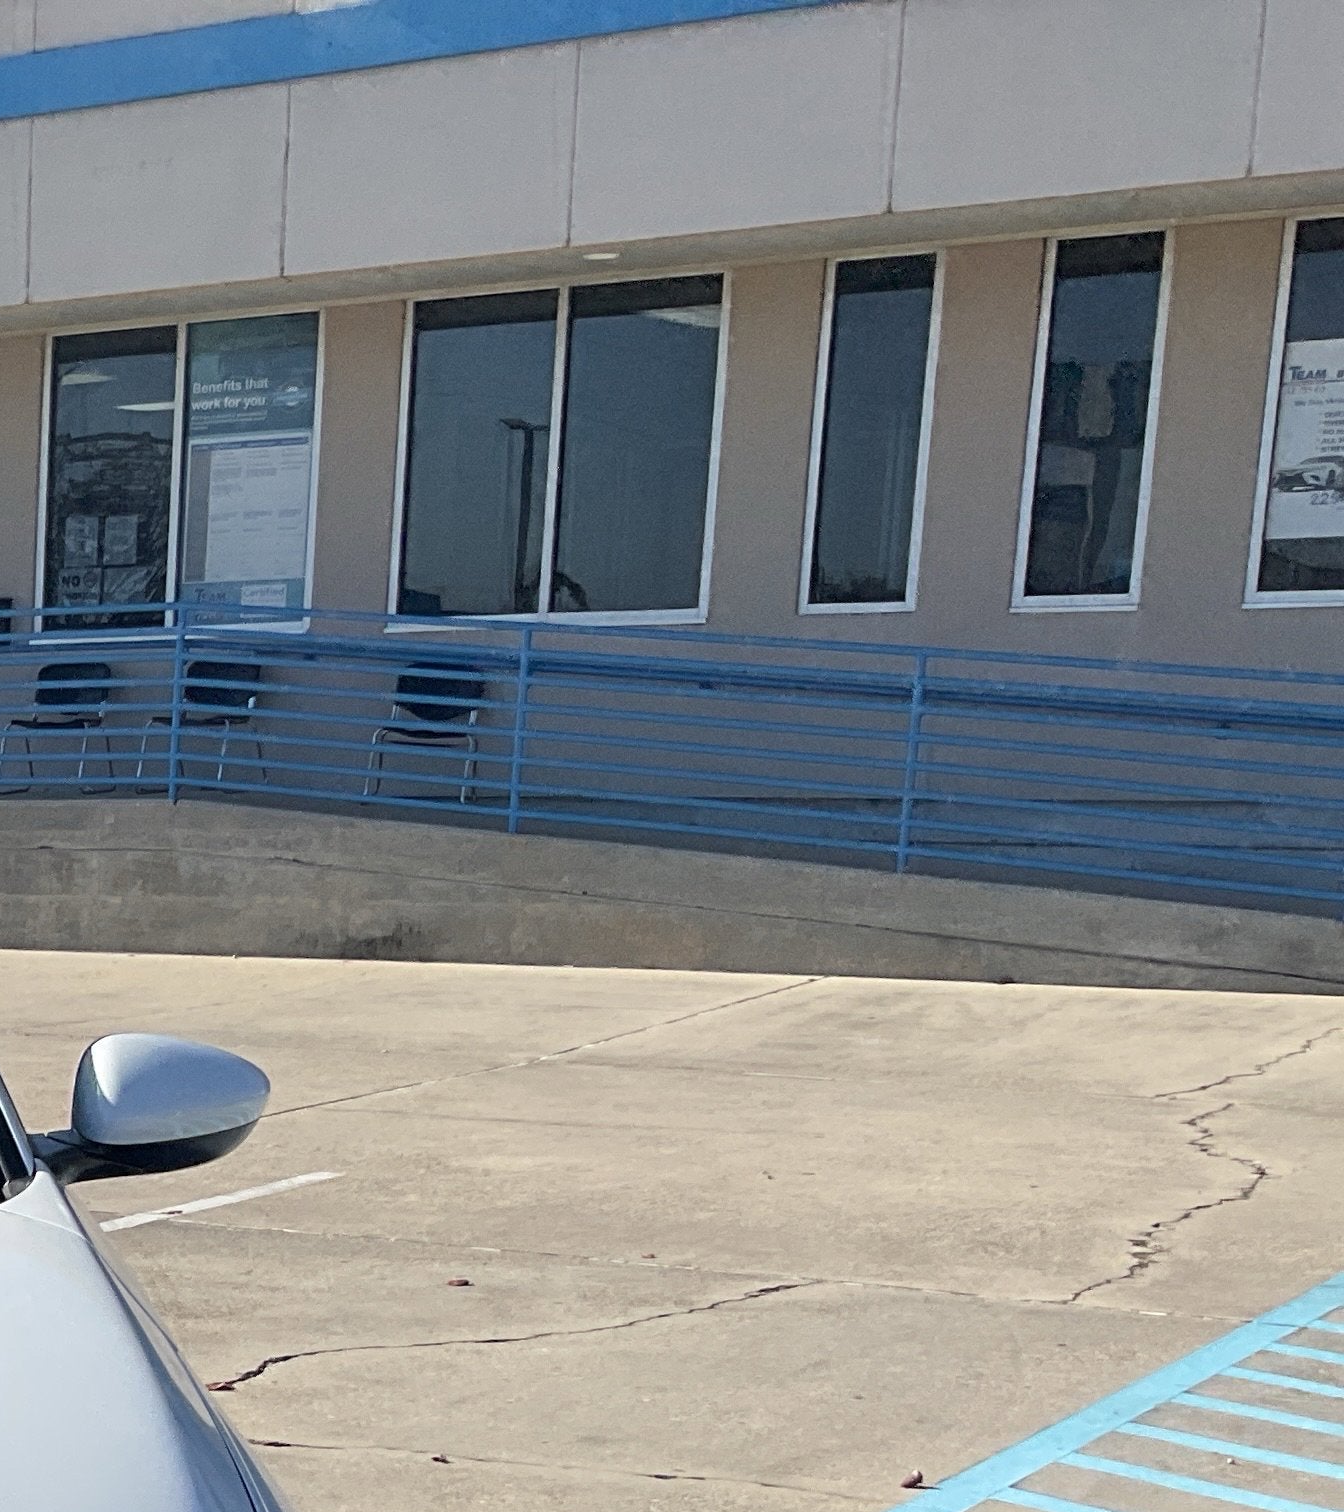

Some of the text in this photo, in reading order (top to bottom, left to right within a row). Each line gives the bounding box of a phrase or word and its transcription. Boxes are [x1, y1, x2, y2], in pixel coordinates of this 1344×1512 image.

[192, 378, 269, 394] Benefits that
[191, 399, 221, 411] work
[224, 396, 241, 408] for
